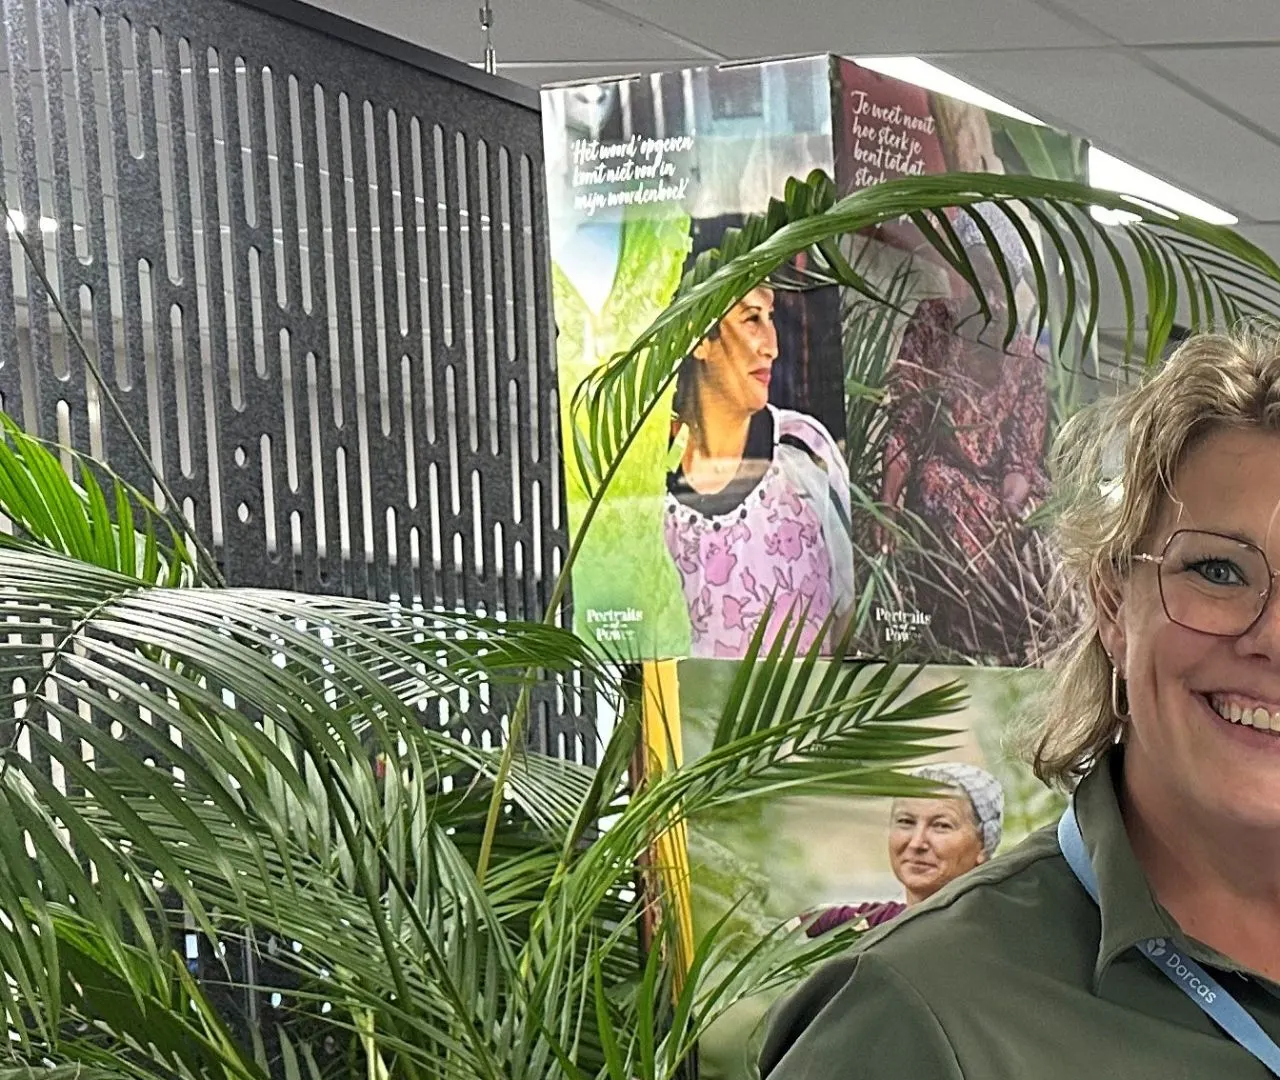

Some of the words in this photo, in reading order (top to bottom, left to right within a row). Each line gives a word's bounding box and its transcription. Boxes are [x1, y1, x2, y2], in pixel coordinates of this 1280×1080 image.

[850, 90, 871, 115] Je
[872, 105, 903, 125] weet
[852, 116, 877, 140] hoe
[878, 125, 908, 151] sterk
[909, 138, 922, 160] je
[854, 139, 884, 168] bent
[607, 159, 635, 183] niet
[660, 161, 676, 177] in
[1165, 952, 1217, 1004] Dorcas
